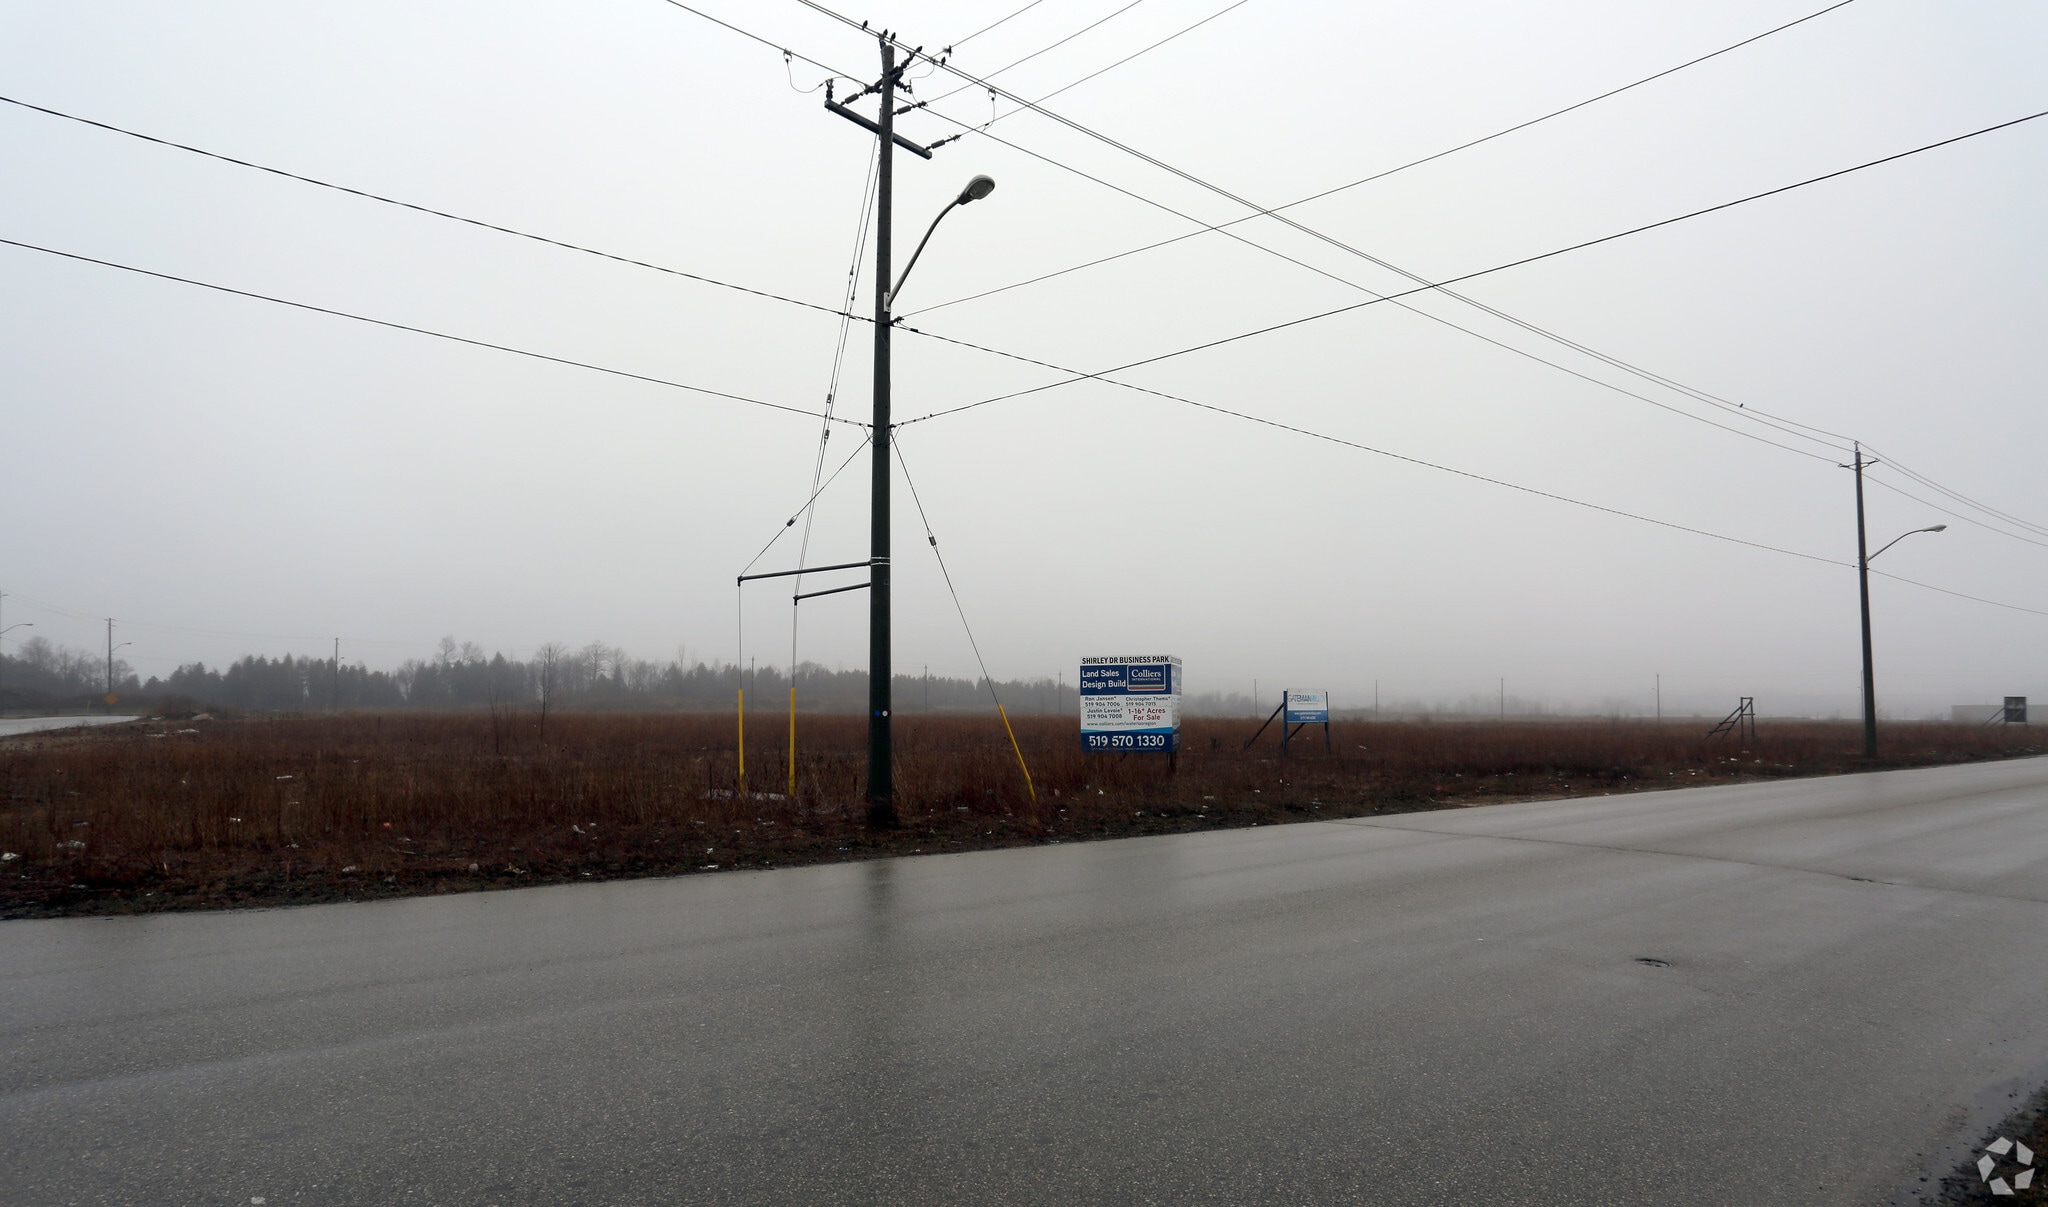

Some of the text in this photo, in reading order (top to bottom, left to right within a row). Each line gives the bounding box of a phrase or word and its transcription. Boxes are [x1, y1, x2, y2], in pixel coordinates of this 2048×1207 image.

[1119, 656, 1151, 664] BUSINESS
[1082, 669, 1120, 678] Land Sales
[1131, 669, 1162, 678] Colliers
[1082, 680, 1126, 690] Design Build
[1089, 735, 1108, 747] 519
[1112, 735, 1133, 747] 570
[1137, 735, 1165, 746] 1330
